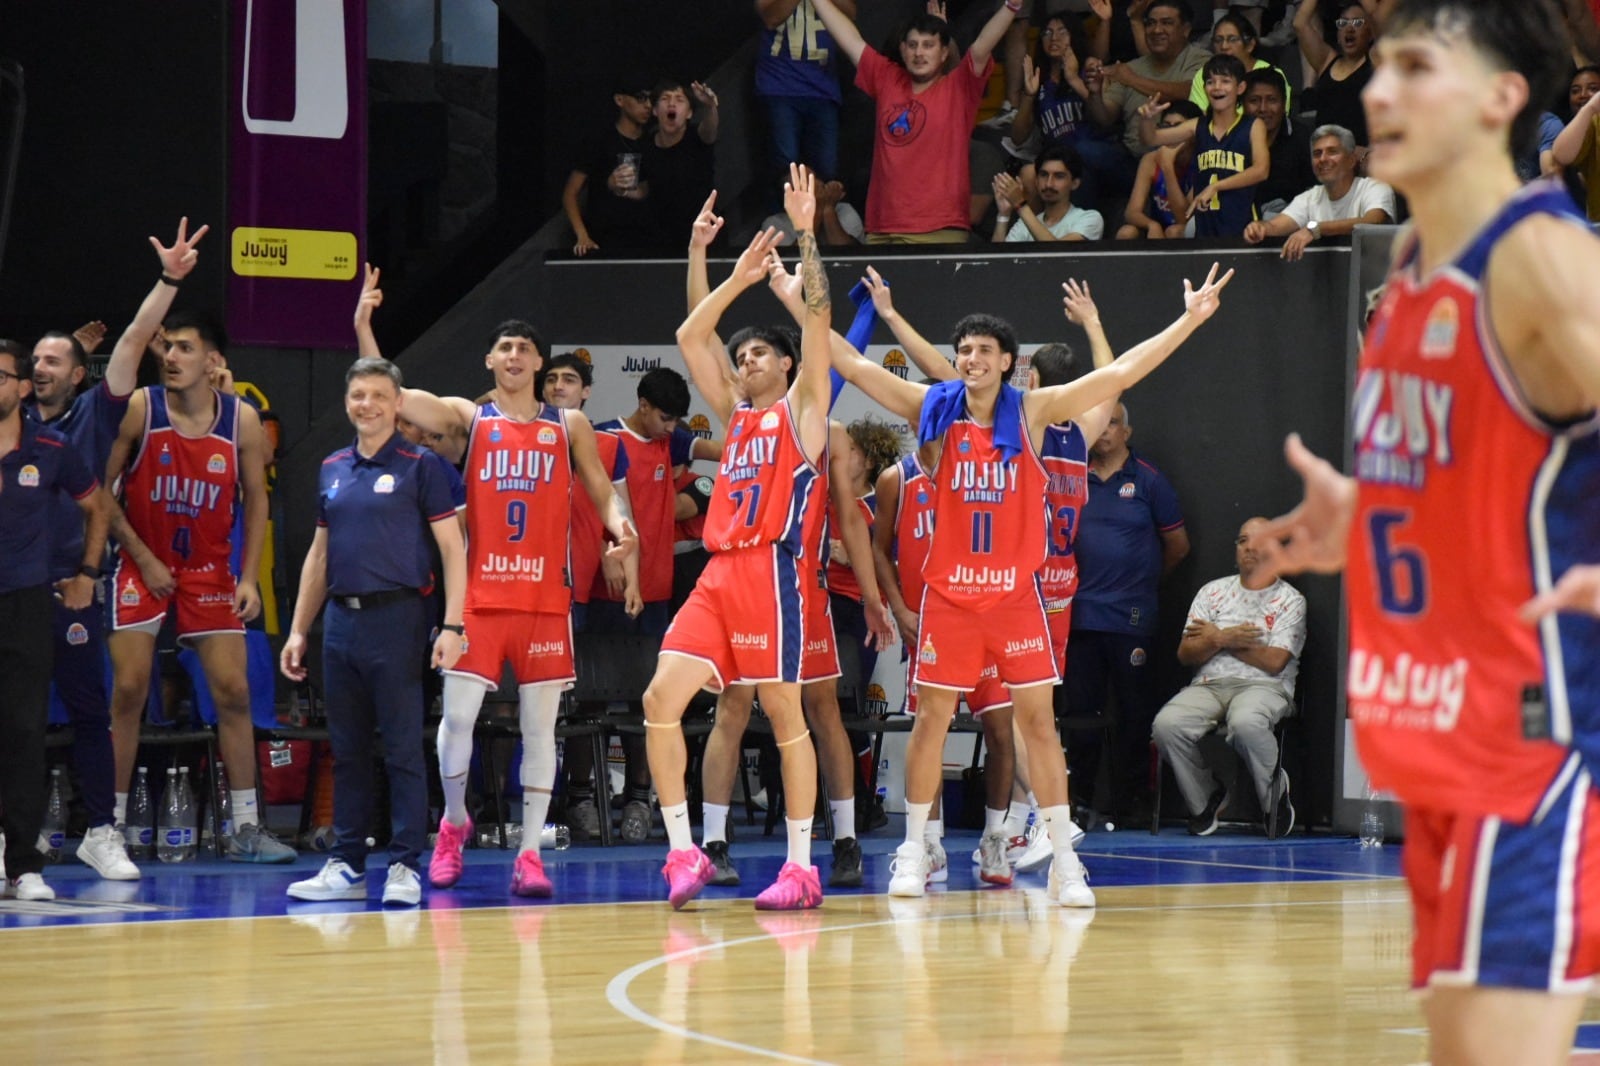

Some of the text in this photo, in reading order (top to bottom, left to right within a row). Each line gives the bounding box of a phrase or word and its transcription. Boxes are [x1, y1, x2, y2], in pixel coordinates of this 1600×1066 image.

[1041, 102, 1083, 135] JUJUY
[480, 450, 556, 483] JUJUY
[720, 435, 779, 476] JUJUY
[151, 474, 222, 511] JUJUY
[951, 460, 1019, 493] JUJUY
[506, 498, 528, 543] 9
[970, 510, 993, 555] 11
[171, 525, 193, 562] 4
[1366, 505, 1429, 621] 6
